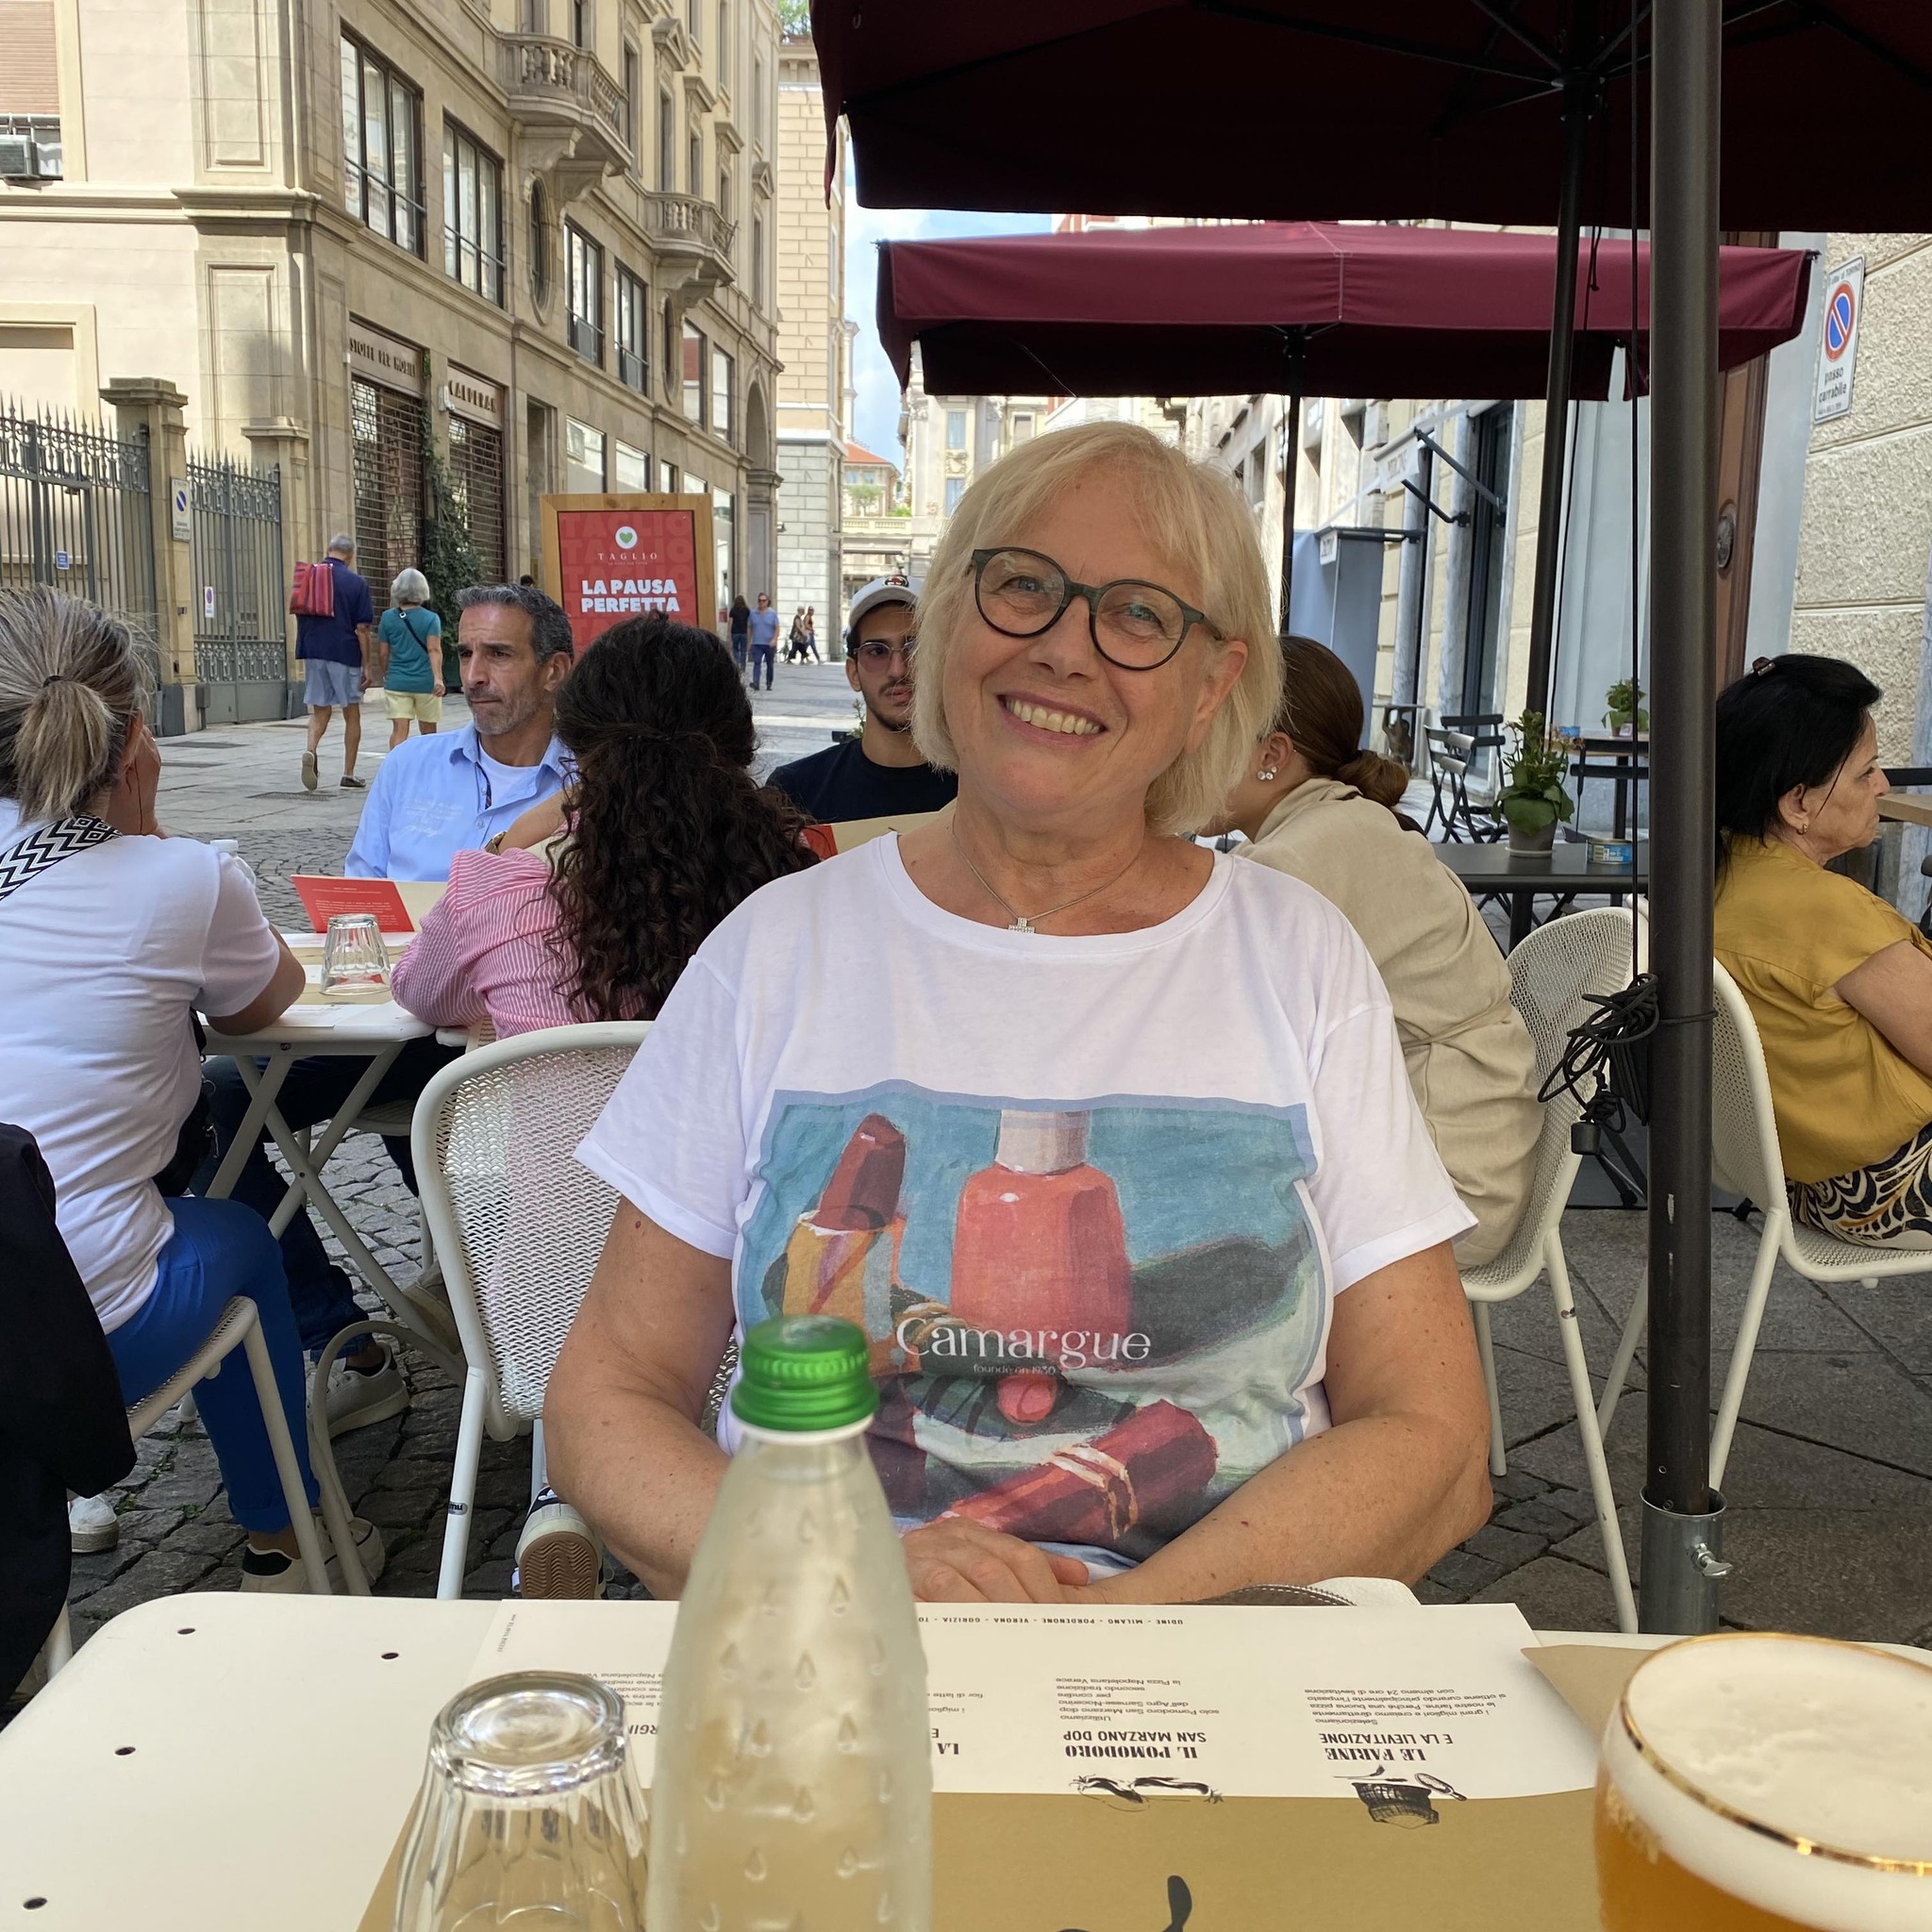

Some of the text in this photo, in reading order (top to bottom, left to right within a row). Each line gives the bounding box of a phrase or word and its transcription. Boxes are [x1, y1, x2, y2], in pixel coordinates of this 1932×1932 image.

[350, 339, 375, 361] STOFFE
[378, 350, 391, 367] PER
[1824, 367, 1843, 385] passo
[1819, 383, 1846, 403] carrabile
[582, 579, 677, 594] LA PAUSA
[581, 597, 680, 612] PERFETTA
[896, 1317, 1152, 1369] Camargue
[1063, 1731, 1206, 1742] SAN MARZANO DOP
[1319, 1733, 1452, 1743] E LA LIEVITAZIONE
[937, 1743, 958, 1755] LA
[1065, 1746, 1197, 1758] IL POMODORO
[1324, 1748, 1426, 1760] LE FARINE
